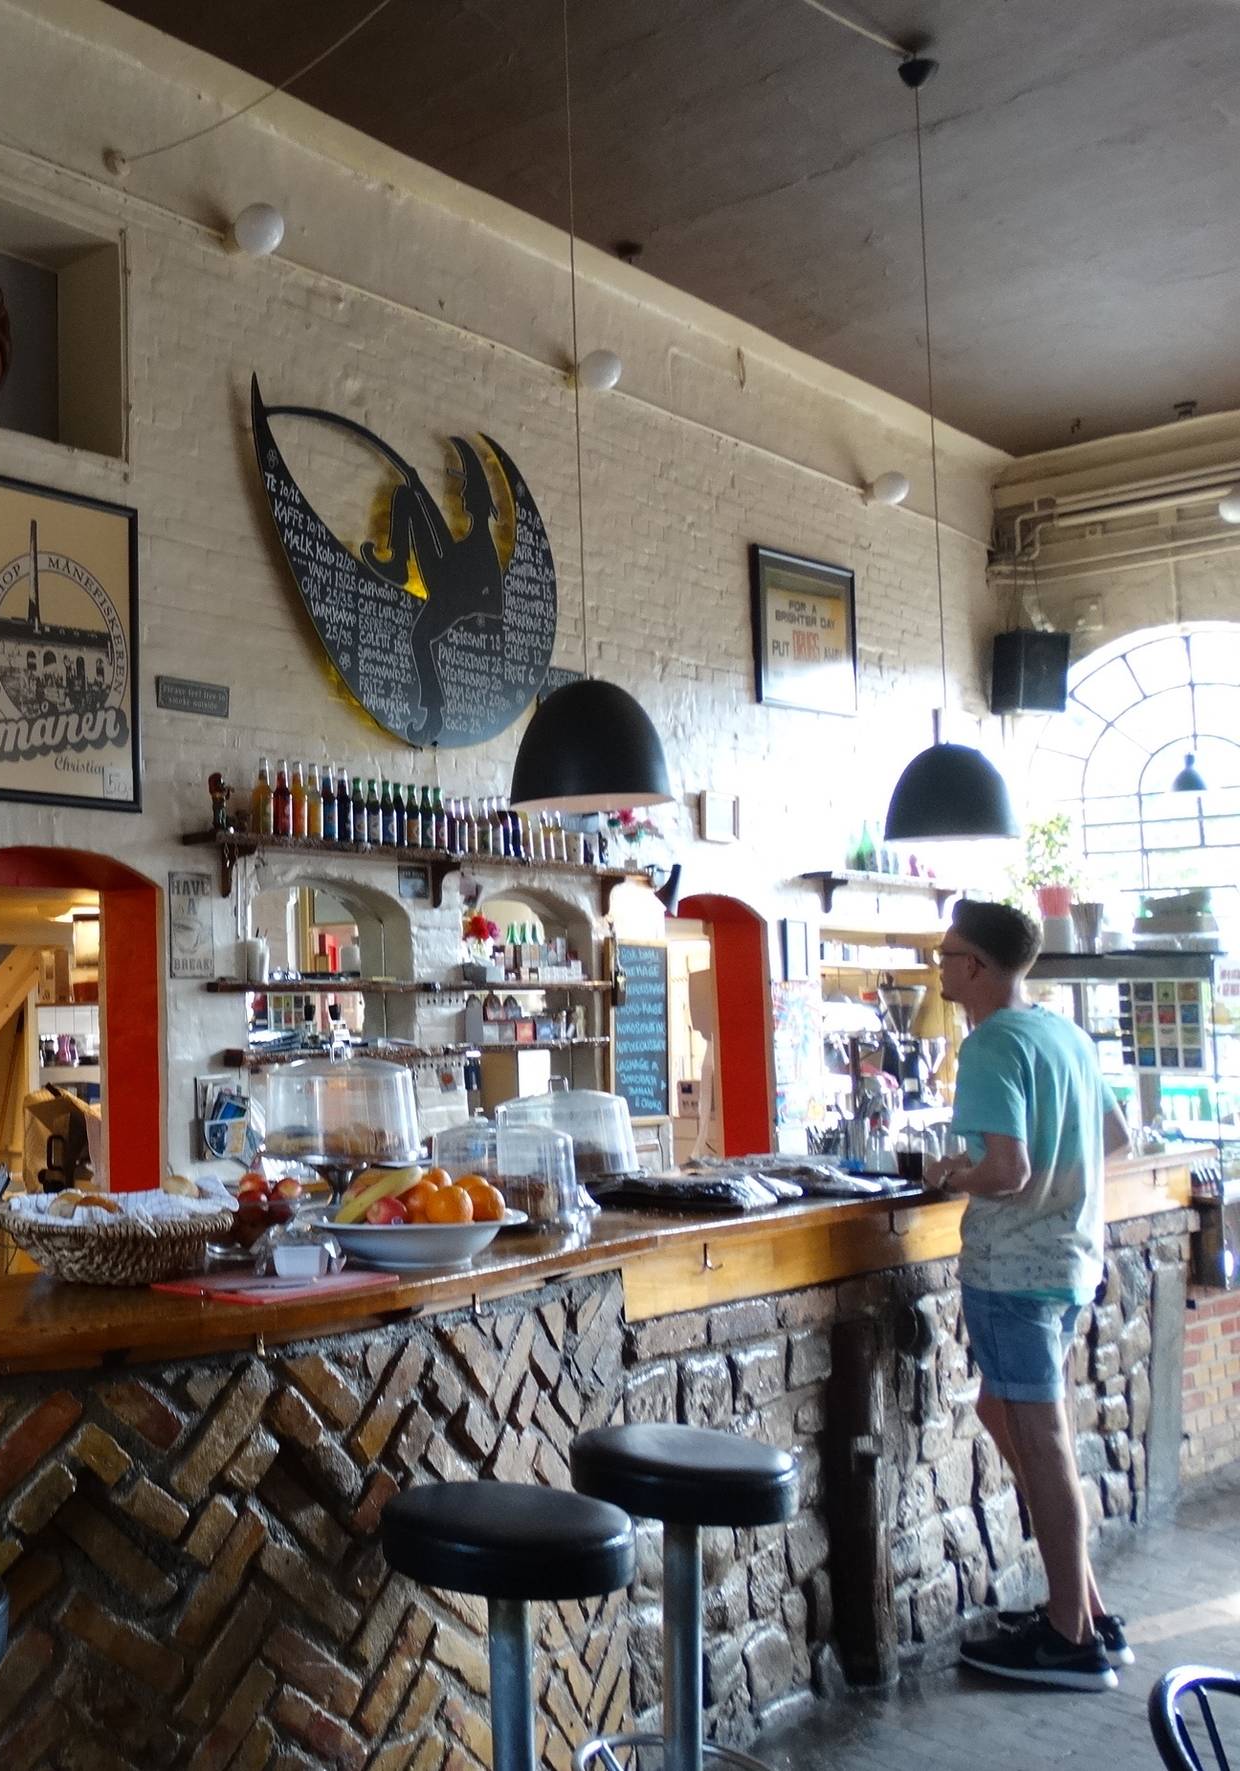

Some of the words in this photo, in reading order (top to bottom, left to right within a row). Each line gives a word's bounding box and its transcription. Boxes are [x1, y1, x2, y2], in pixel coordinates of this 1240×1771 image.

[265, 472, 277, 492] TE
[274, 498, 304, 530] KAFFE
[788, 599, 806, 612] FOR
[775, 609, 817, 627] BRIGHTER
[820, 616, 836, 629] DAY
[504, 643, 529, 663] CHIPS
[772, 639, 790, 657] PUT
[172, 880, 211, 896] HAVE
[187, 898, 197, 914] A
